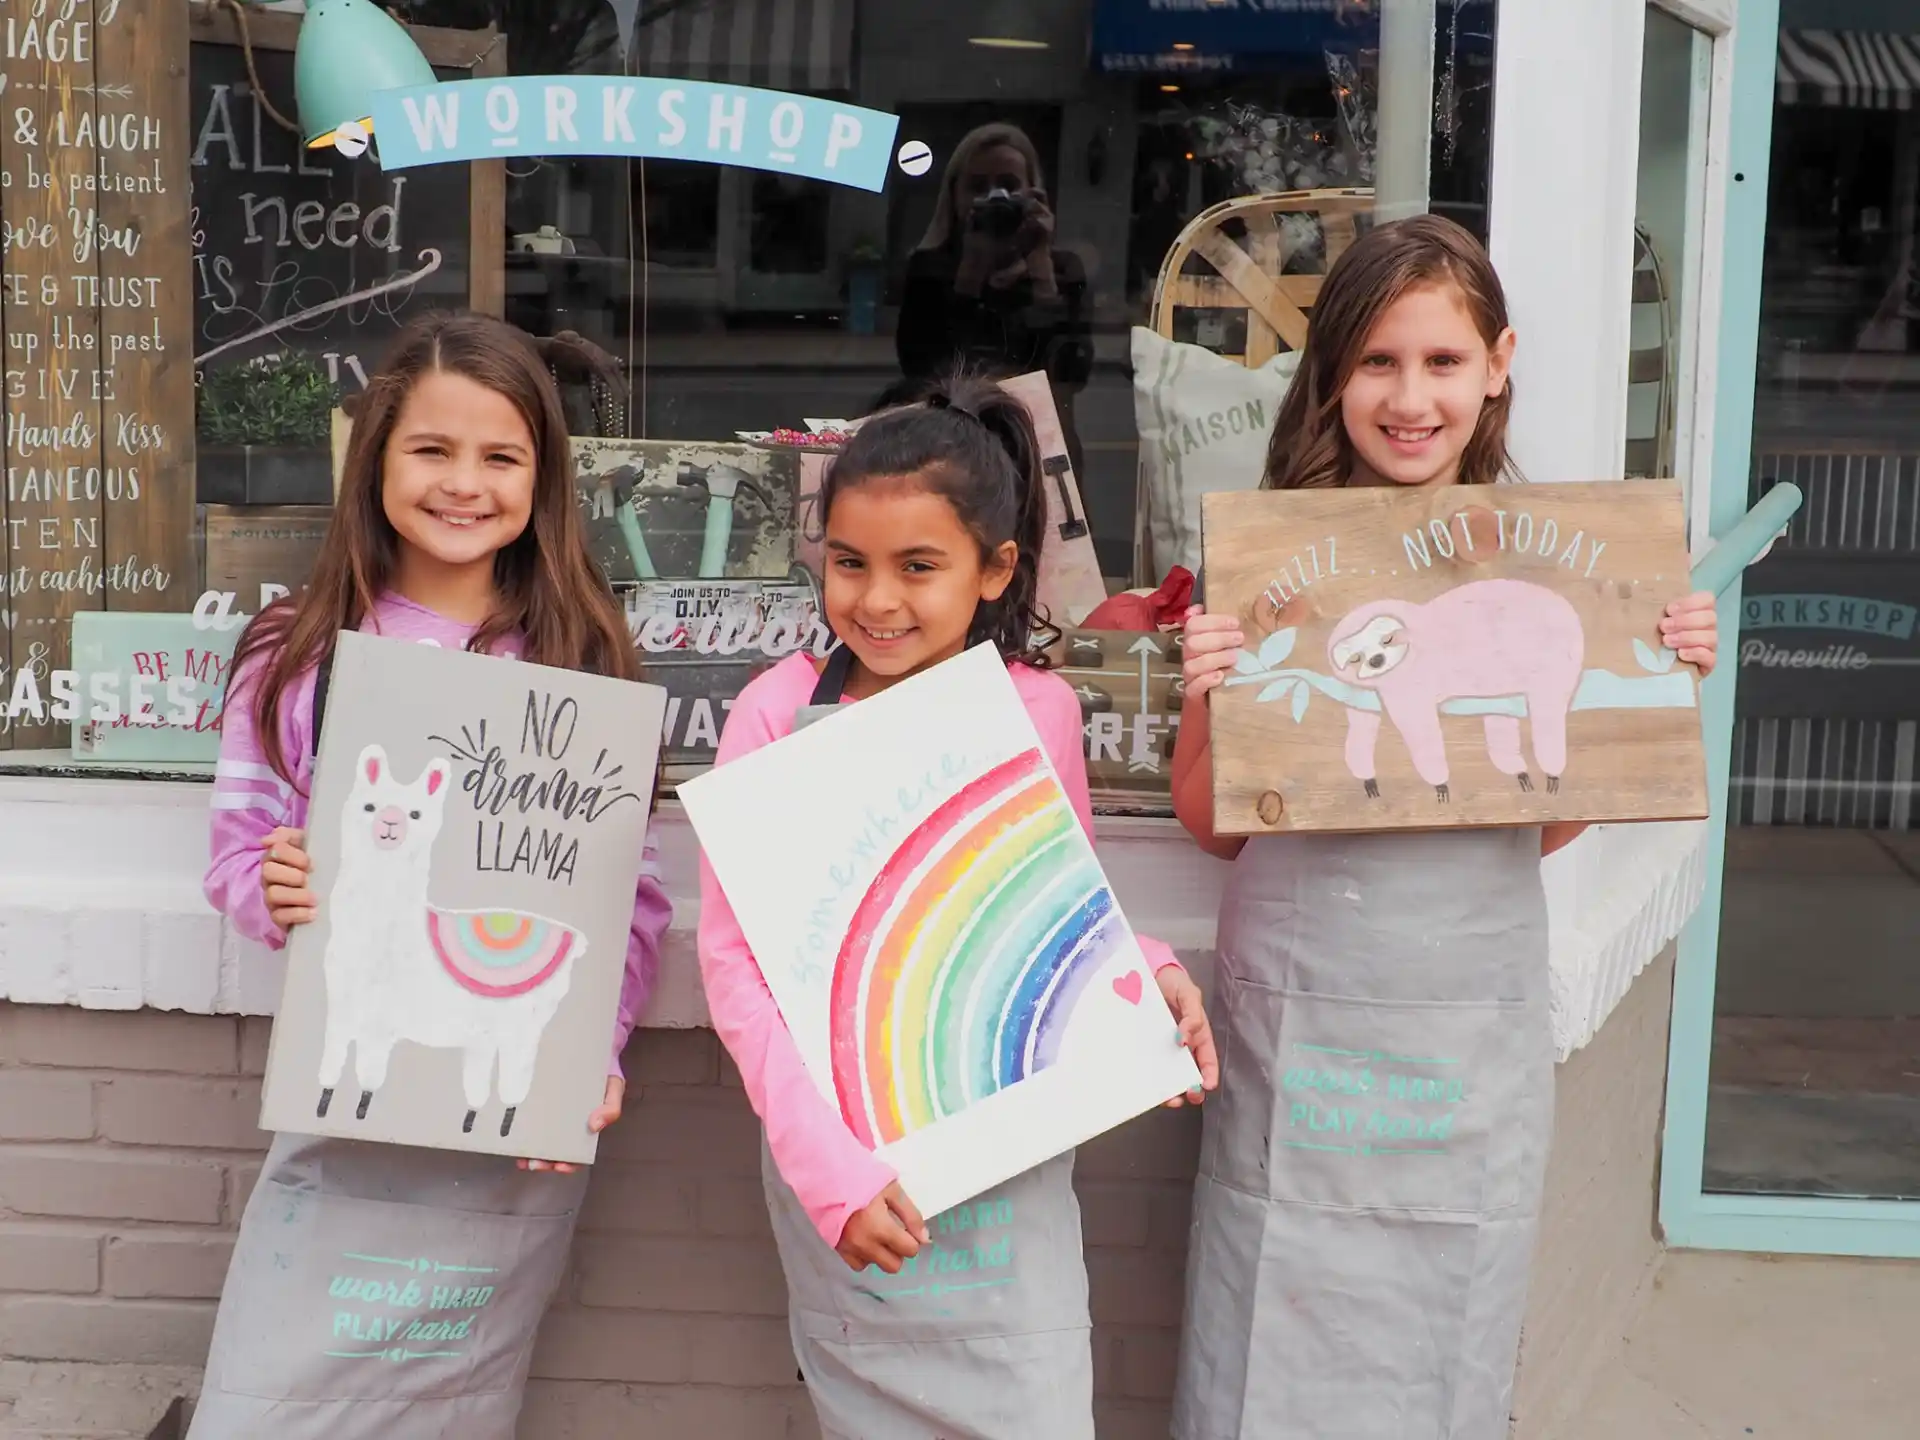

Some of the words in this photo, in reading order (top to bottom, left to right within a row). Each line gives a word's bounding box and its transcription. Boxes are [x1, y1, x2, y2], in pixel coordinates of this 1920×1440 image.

[14, 107, 38, 146] &
[57, 111, 160, 151] LAUGH
[402, 85, 863, 168] WORKSHOP
[27, 153, 51, 188] be
[70, 156, 166, 206] patient
[68, 207, 141, 262] You
[239, 176, 407, 252] need
[71, 276, 162, 308] TRUST
[9, 332, 38, 364] up
[53, 315, 95, 350] the
[110, 316, 164, 365] past
[7, 411, 96, 457] Hands
[114, 412, 167, 455] Kiss
[1403, 512, 1474, 571] NOT
[670, 588, 695, 598] JOIN
[700, 588, 713, 598] US
[717, 588, 730, 598] TO
[185, 648, 232, 686] MY
[1742, 640, 1872, 669] Pineville
[521, 689, 578, 760] NO
[477, 820, 579, 886] LLAMA
[1388, 1074, 1463, 1103] HARD
[1289, 1100, 1358, 1134] PLAY
[937, 1198, 1013, 1235] HARD
[927, 1235, 1015, 1275] hard
[329, 1275, 424, 1308] work
[430, 1285, 496, 1309] HARD
[333, 1310, 402, 1341] PLAY
[397, 1314, 477, 1341] hard
